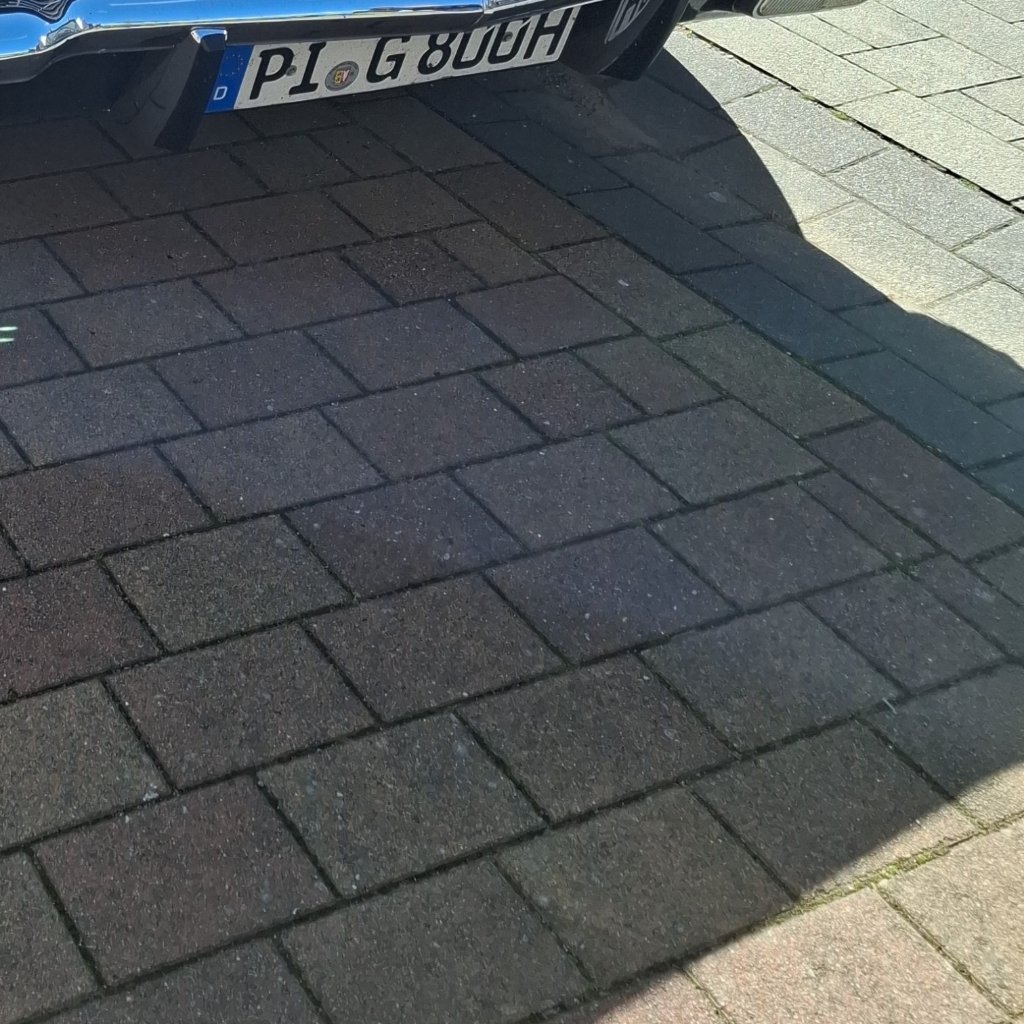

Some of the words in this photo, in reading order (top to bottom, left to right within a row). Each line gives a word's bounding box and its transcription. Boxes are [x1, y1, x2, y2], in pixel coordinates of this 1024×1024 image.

[249, 41, 327, 100] PI
[366, 35, 412, 83] G
[417, 7, 574, 75] 800H
[213, 86, 228, 101] D
